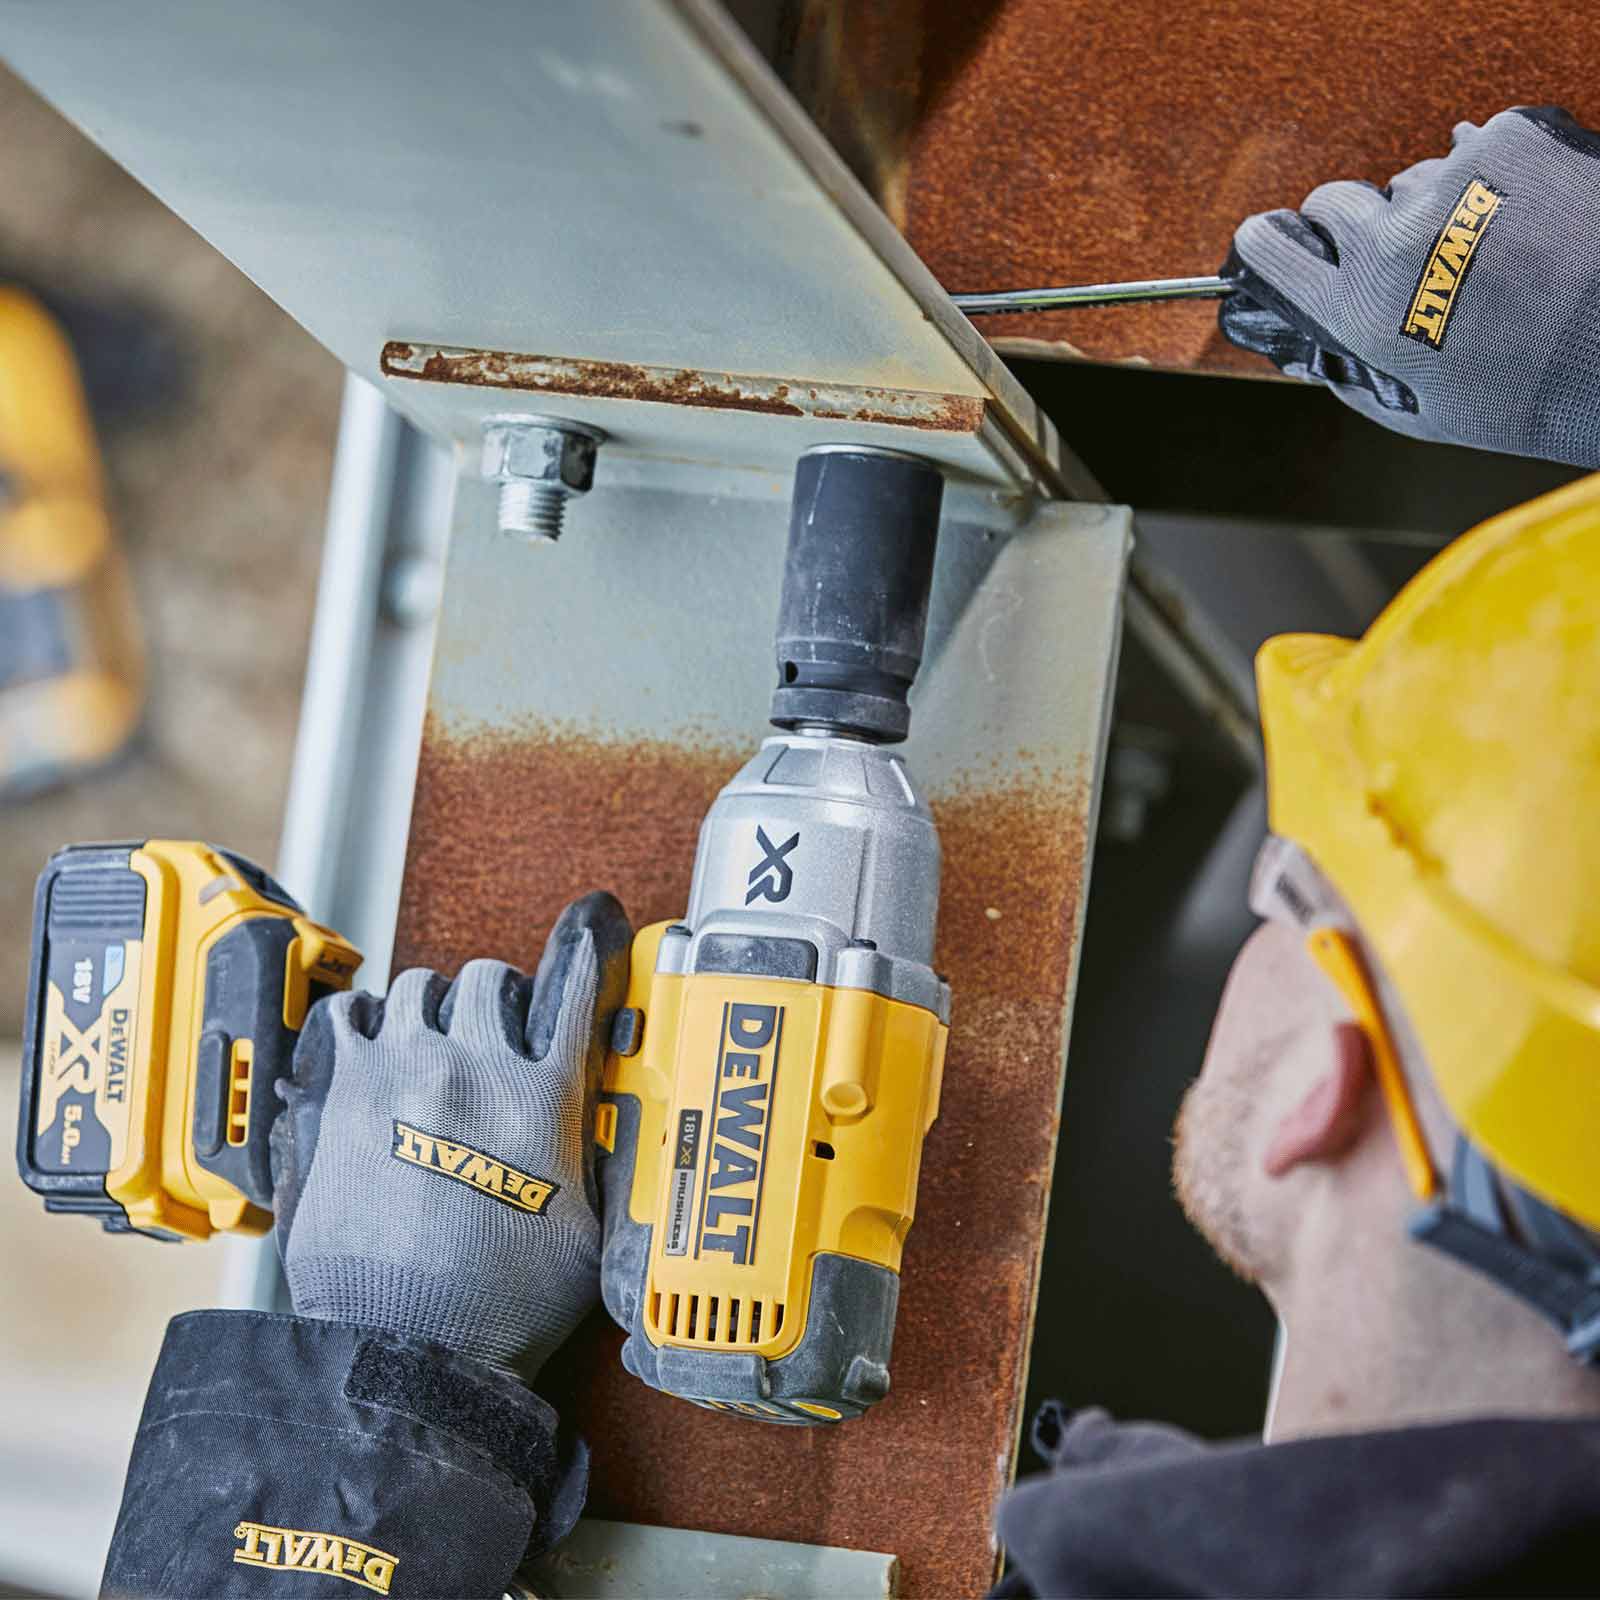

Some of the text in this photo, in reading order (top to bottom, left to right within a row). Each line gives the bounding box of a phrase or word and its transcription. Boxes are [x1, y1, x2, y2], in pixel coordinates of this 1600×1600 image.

[1411, 181, 1499, 341] DEWALT
[745, 824, 800, 906] XR
[72, 957, 93, 1004] 18V
[107, 1008, 128, 1103] DEWALT
[397, 1128, 552, 1209] DEWALT
[683, 1114, 696, 1144] 18V
[702, 1003, 777, 1265] DEWALT
[671, 1172, 687, 1249] BRUSHLESS
